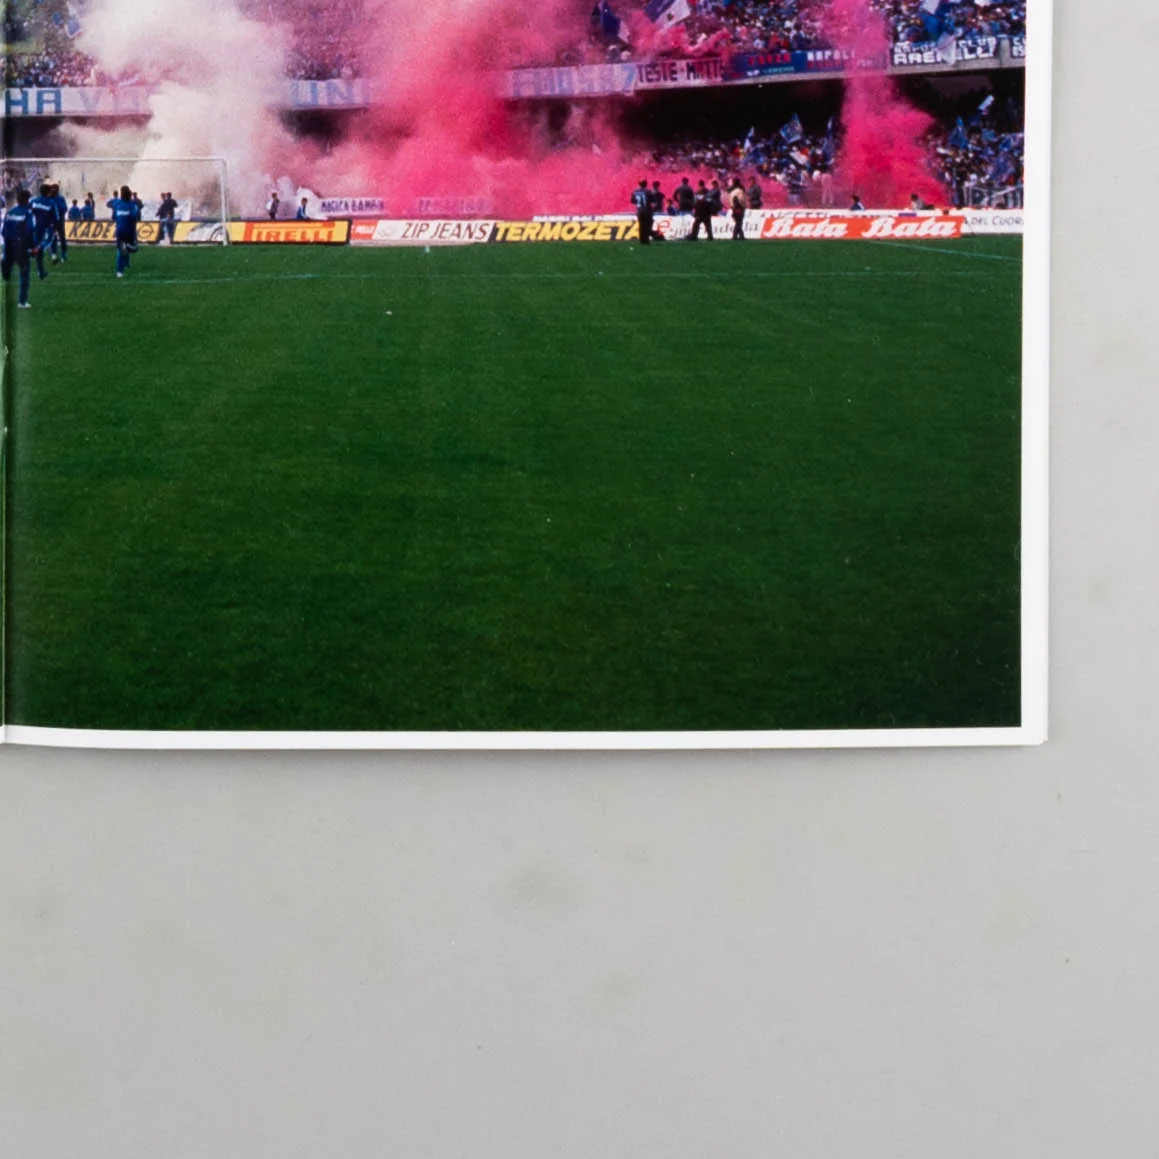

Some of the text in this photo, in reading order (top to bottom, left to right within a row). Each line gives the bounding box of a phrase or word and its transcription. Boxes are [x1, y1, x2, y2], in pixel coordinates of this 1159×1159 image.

[242, 221, 336, 242] PIRELLI
[401, 222, 490, 240] ZIP JEANS
[494, 220, 640, 241] TERMOZETA
[762, 215, 848, 238] Bata
[861, 215, 957, 238] Bata
